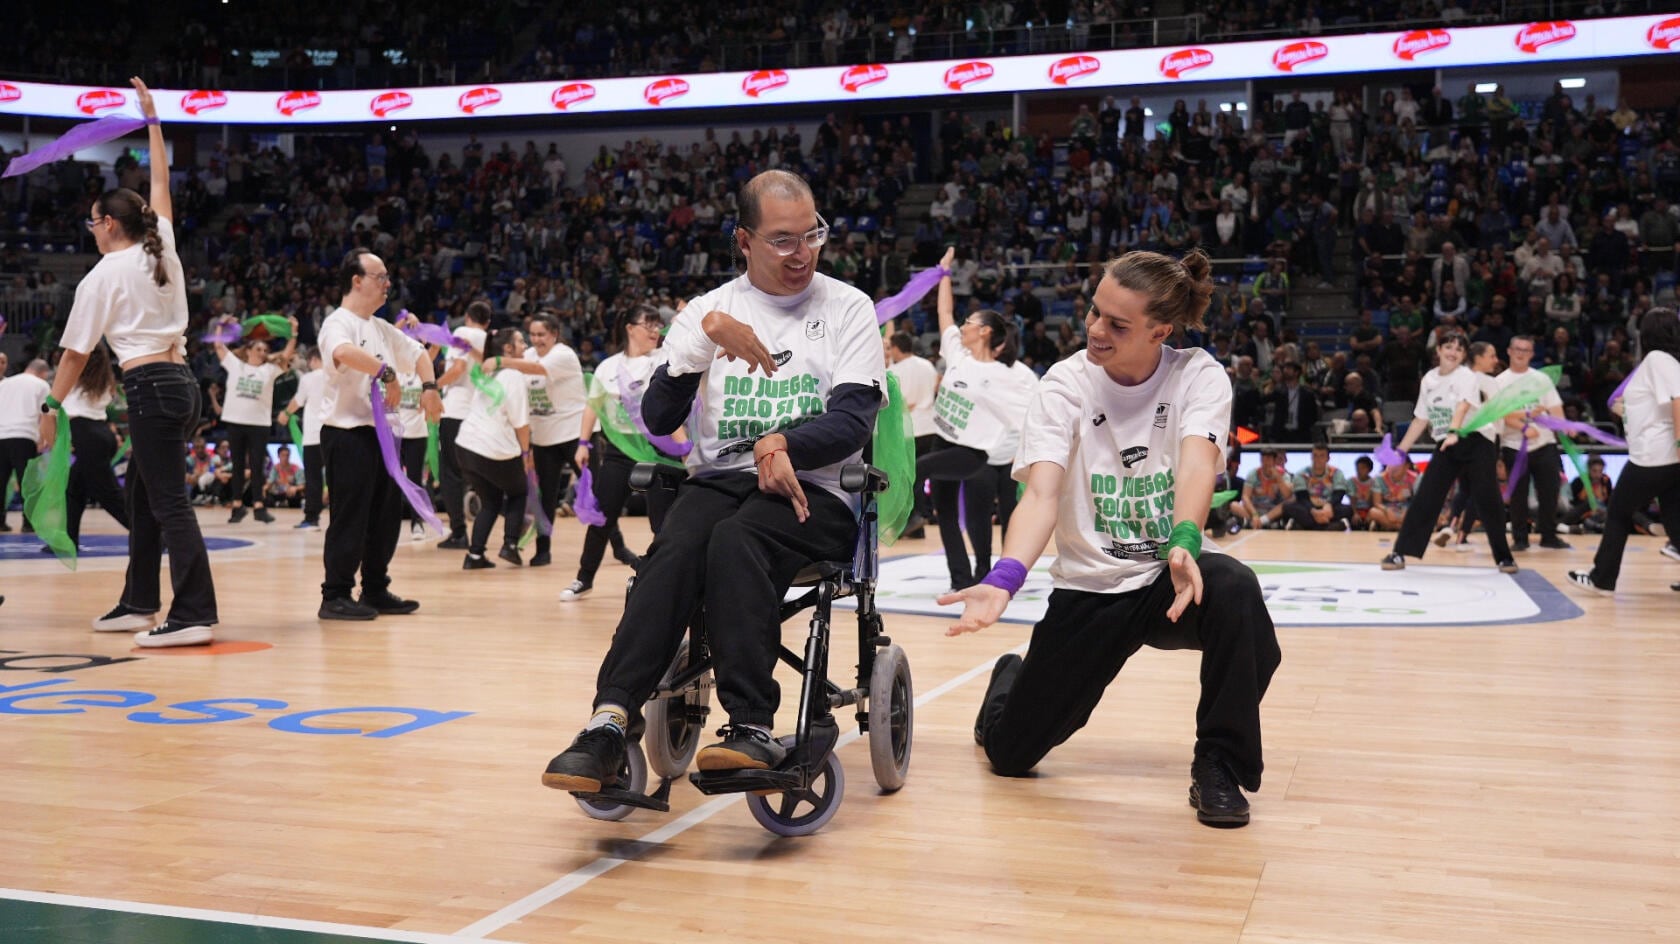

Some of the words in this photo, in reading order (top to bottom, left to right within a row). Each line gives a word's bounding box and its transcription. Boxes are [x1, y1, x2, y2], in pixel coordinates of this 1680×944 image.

[724, 376, 752, 396] NO
[723, 398, 772, 418] SOLO
[776, 399, 794, 416] SI
[797, 396, 823, 415] YO
[1091, 474, 1117, 494] NO
[1120, 468, 1175, 498] JUEGAS
[1135, 500, 1153, 519] SI
[1154, 490, 1175, 514] YO
